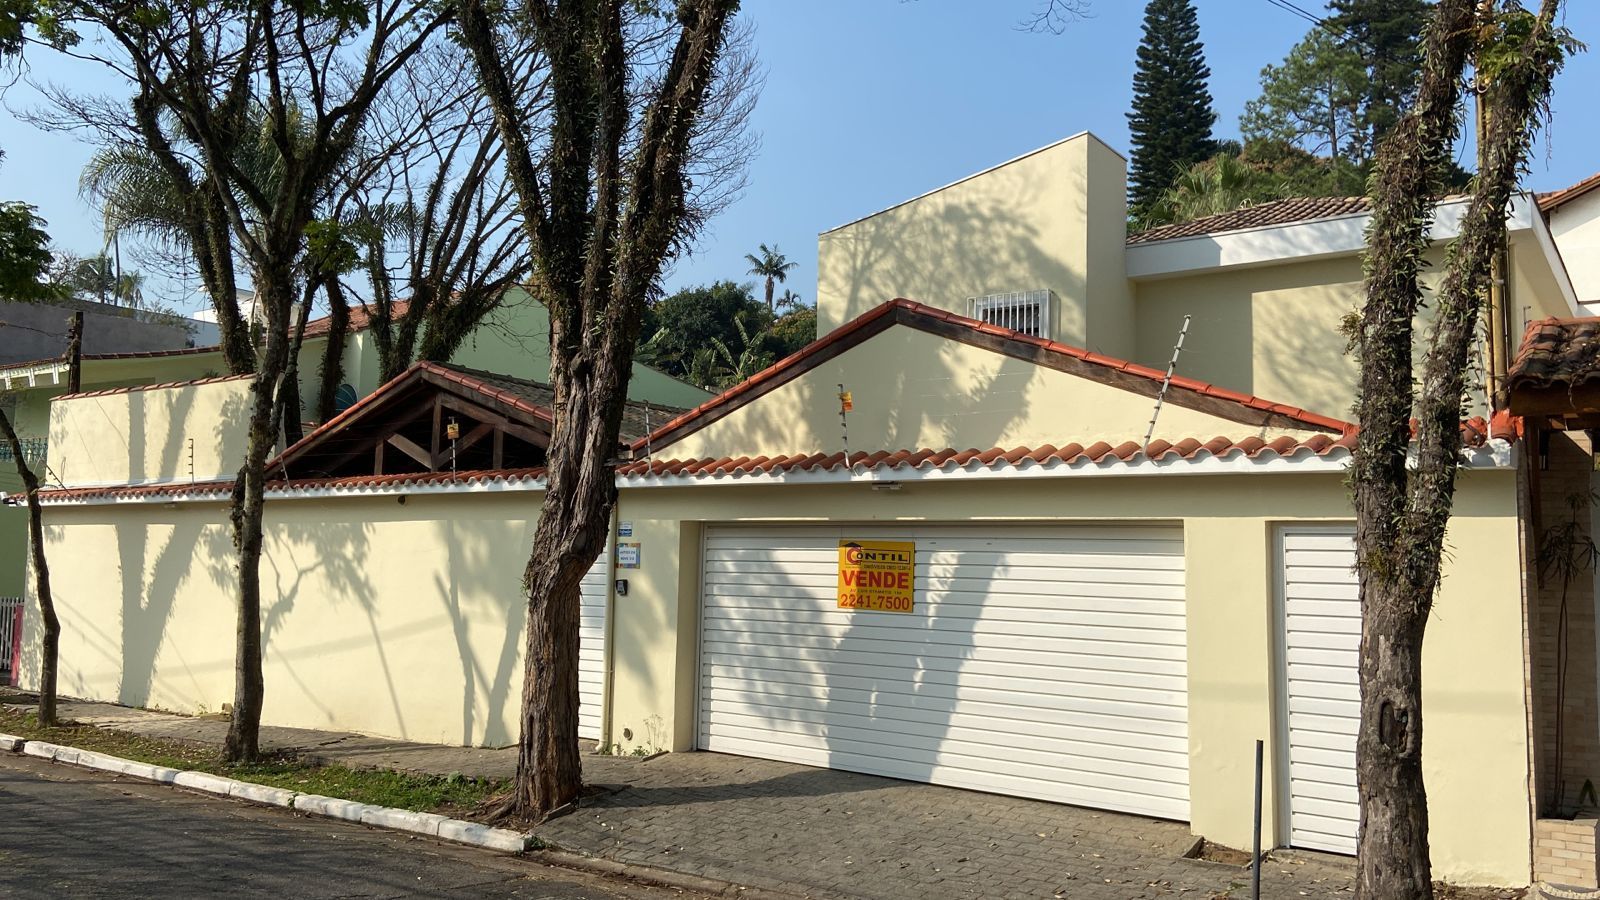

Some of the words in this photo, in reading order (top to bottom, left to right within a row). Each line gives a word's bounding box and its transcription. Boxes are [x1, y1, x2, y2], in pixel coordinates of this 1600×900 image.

[846, 547, 908, 565] CONTIL
[841, 570, 909, 589] VENDE
[840, 593, 910, 610] 2241-7500
